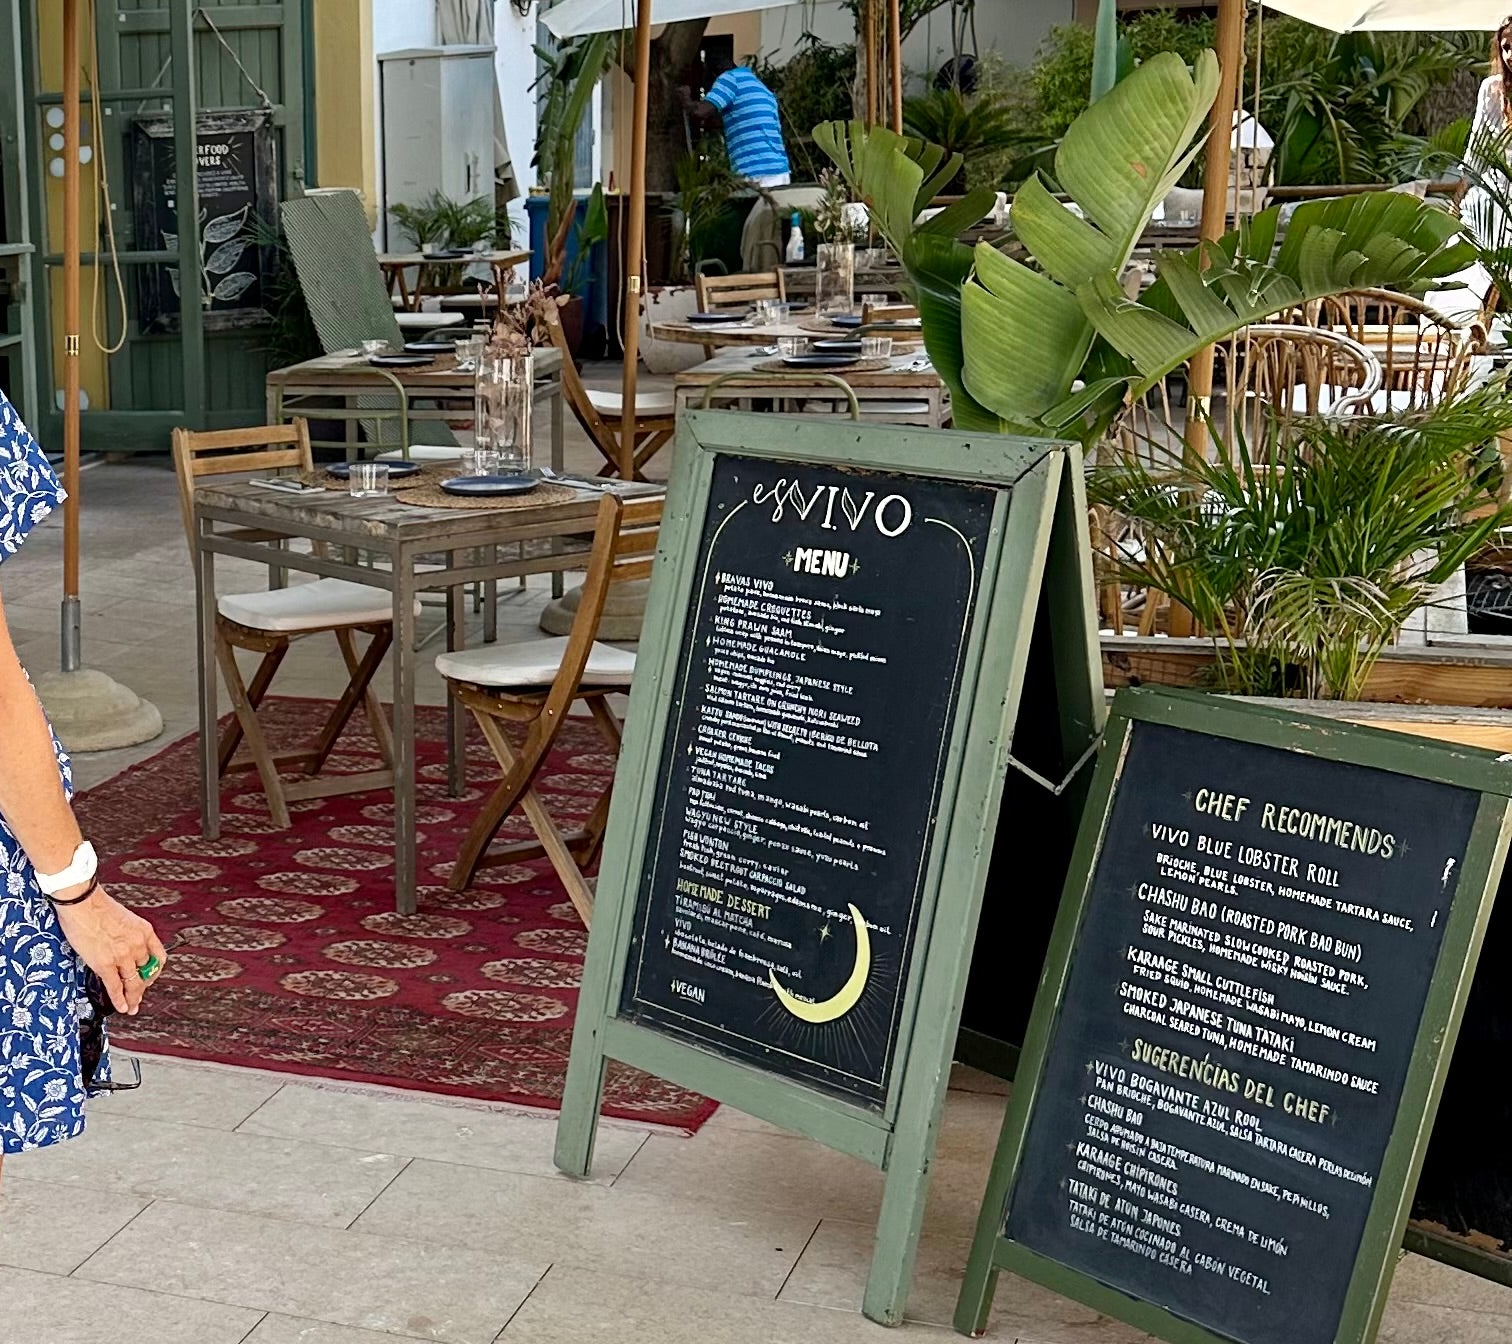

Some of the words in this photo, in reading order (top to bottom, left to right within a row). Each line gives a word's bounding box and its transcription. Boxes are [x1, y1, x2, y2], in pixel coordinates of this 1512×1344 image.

[196, 144, 229, 155] RFOOD
[196, 156, 221, 166] VERS
[788, 479, 912, 537] VIVO
[720, 572, 751, 587] BRAVAS
[753, 578, 774, 592] VIVO
[793, 546, 850, 578] MENU
[714, 614, 735, 628] KING
[737, 618, 768, 634] PRAWN
[733, 819, 758, 835] STYLE
[1195, 788, 1251, 822] CHEF
[1261, 802, 1396, 858] RECOMMENDS
[1152, 823, 1189, 847] VIVO
[1196, 835, 1233, 859] BLUE
[1237, 845, 1299, 878] LOBSTER
[1306, 863, 1339, 888] ROLL
[676, 877, 724, 905] HOMEMADE
[726, 893, 772, 920] DESSERT
[1160, 866, 1196, 884] LEMON
[1198, 876, 1239, 896] PEARLS.
[1203, 865, 1229, 882] BLUE
[1232, 873, 1275, 897] LOBSTER,
[1277, 885, 1333, 909] HOMEMADE
[1335, 900, 1380, 921] TARTARA
[1381, 913, 1414, 933] SAUCE,
[1137, 882, 1189, 912] CHASHU
[1190, 897, 1218, 920] BAO
[1220, 905, 1275, 935] (ROASTED
[1276, 921, 1309, 946] PORK
[1309, 931, 1333, 953] BAO
[1334, 939, 1362, 963] BUN)
[1142, 922, 1166, 939] SOUR
[1167, 930, 1206, 953] PICKLES,
[1208, 942, 1259, 967] HOMEMADE
[1319, 977, 1350, 996] SAUCE.
[1143, 909, 1168, 928] SAKE
[1168, 918, 1221, 943] MARINATED
[1224, 934, 1251, 952] SLOW
[1251, 943, 1290, 966] COOKED
[1293, 955, 1336, 977] ROASTED
[1338, 968, 1369, 990] PORK,
[676, 980, 706, 1003] VEGAN
[1127, 945, 1179, 975] KARAAGE
[1181, 963, 1213, 987] SMALL
[1215, 976, 1275, 1006] CUTTLEFISH
[1119, 981, 1168, 1009] SMOKED
[1168, 998, 1223, 1029] JAPANESE
[1226, 1016, 1253, 1039] TUNA
[1254, 1026, 1295, 1053] TATAKI
[1133, 964, 1162, 981] FRIED
[1193, 983, 1243, 1008] HOMEMADE
[1307, 1020, 1341, 1040] LEMON
[1341, 1031, 1377, 1052] CREAM
[1123, 1002, 1167, 1026] CHARCOAL
[1168, 1015, 1201, 1036] SEARED
[1202, 1027, 1225, 1046] TUNA,
[1228, 1036, 1287, 1066] HOMEMADE
[1290, 1056, 1349, 1085] TAMARINDO
[1350, 1075, 1379, 1095] SAUCE
[1087, 1094, 1125, 1119] CHASHU
[1125, 1108, 1143, 1126] BAO
[1095, 1059, 1126, 1083] VIVO
[1130, 1072, 1200, 1109] BOGAVANTE
[1202, 1099, 1231, 1121] AZUL
[1234, 1109, 1263, 1132] ROOL
[1095, 1076, 1115, 1093] PAN
[1116, 1084, 1156, 1111] BRIOCHE,
[1156, 1098, 1206, 1126] BOGAVANTE
[1243, 1078, 1274, 1108] DEL
[1283, 1092, 1330, 1124] CHEF
[1075, 1141, 1123, 1172] KARAAGE
[1123, 1161, 1178, 1196] CHIPIRONES
[1068, 1178, 1098, 1203] TATAKI
[1098, 1191, 1112, 1209] DE
[1096, 1226, 1109, 1241] DE
[1098, 1212, 1111, 1226] DE
[1179, 1246, 1190, 1261] AL
[1215, 1216, 1245, 1238] CREMA
[1247, 1230, 1260, 1244] DE
